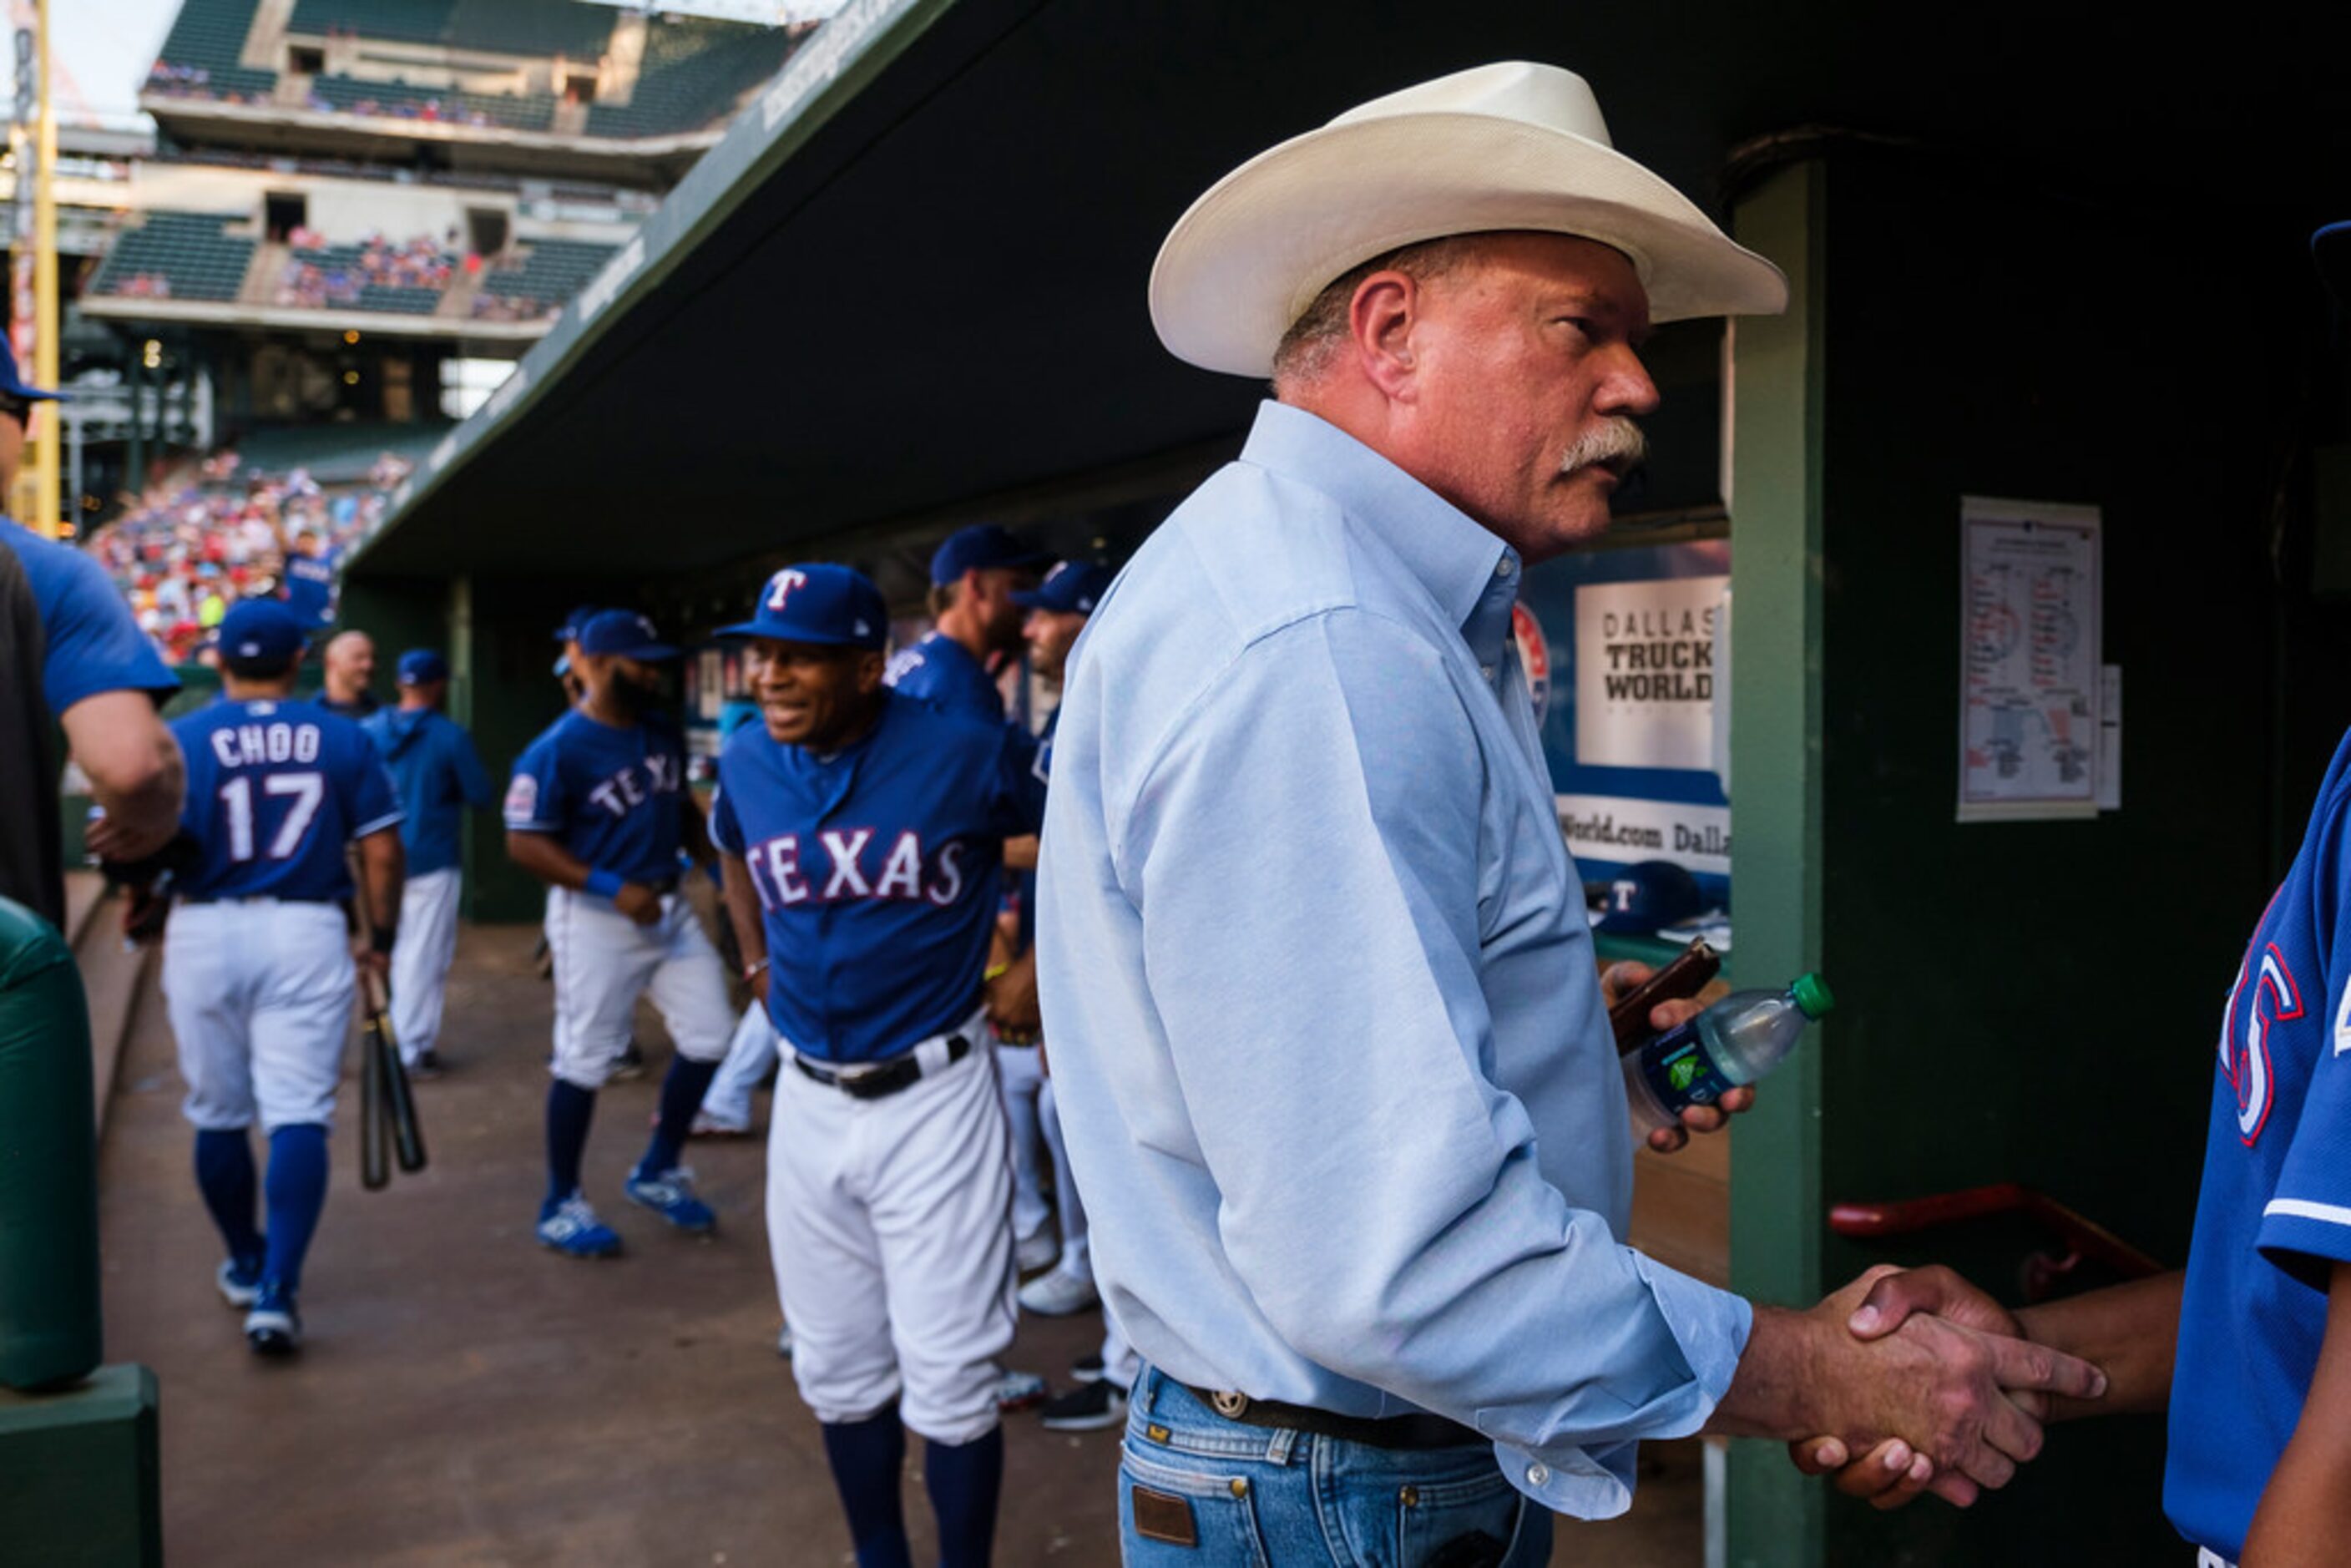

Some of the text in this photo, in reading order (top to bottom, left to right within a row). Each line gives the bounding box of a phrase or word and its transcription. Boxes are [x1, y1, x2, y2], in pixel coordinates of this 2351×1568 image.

[766, 568, 807, 611] T
[1604, 609, 1713, 638] DALLAS
[1605, 640, 1713, 670] TRUCK
[1605, 673, 1712, 701] WORLD
[211, 722, 320, 767] CHOO
[220, 771, 324, 862] 17
[746, 827, 965, 913] TEXAS
[1612, 879, 1638, 912] T
